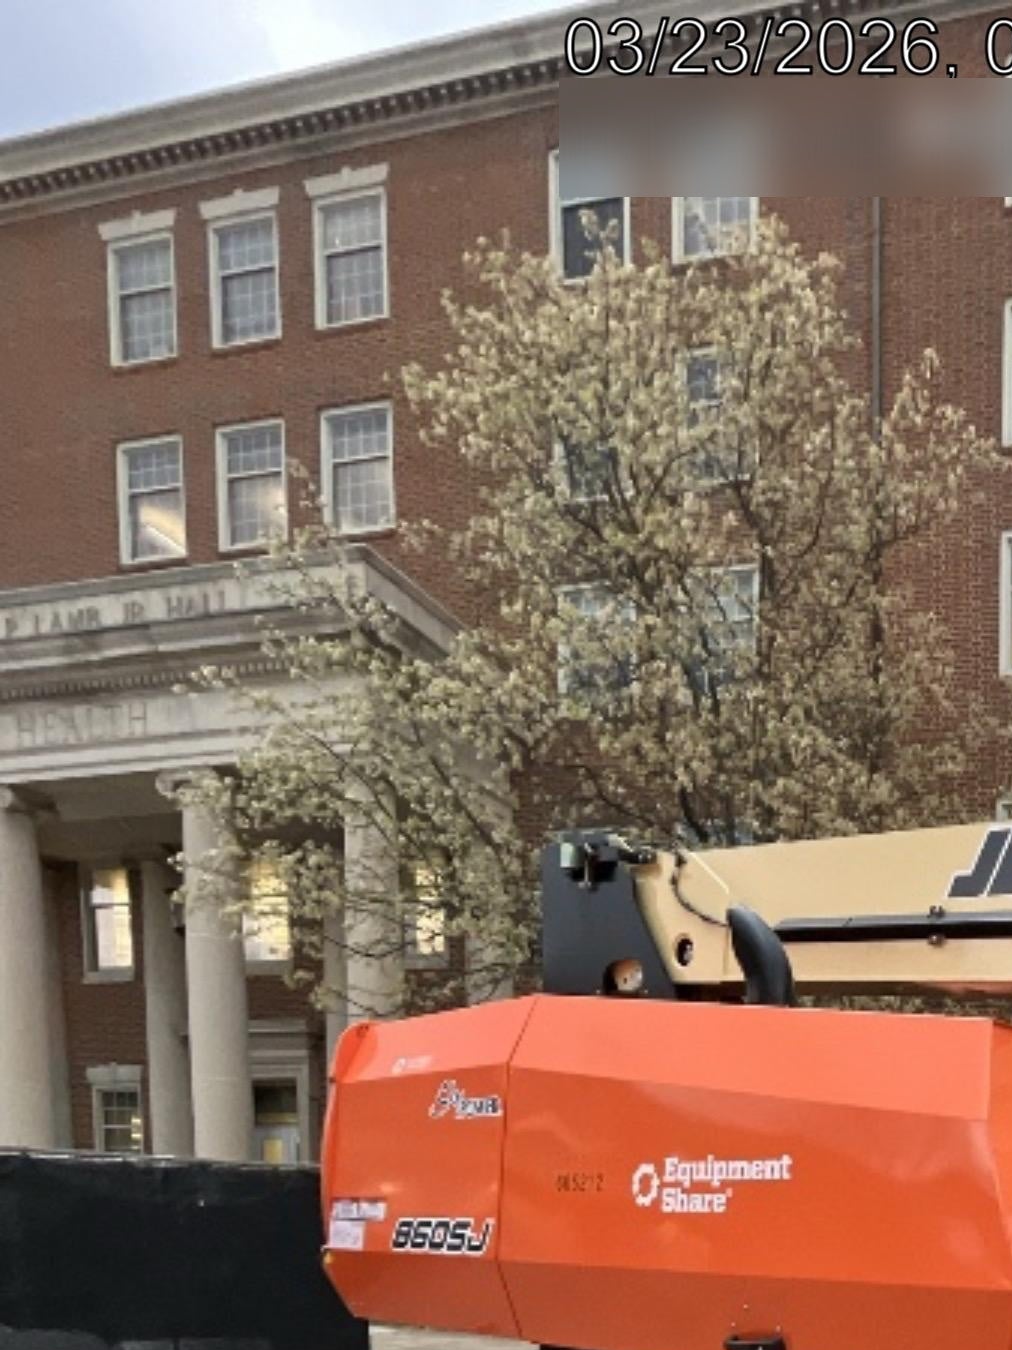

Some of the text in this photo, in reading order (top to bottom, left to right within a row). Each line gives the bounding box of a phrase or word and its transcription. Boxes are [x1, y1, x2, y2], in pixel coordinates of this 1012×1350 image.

[16, 702, 148, 748] HEALTH
[663, 1154, 793, 1188] Equipment
[661, 1188, 728, 1213] Share
[391, 1218, 493, 1255] 860SJ
